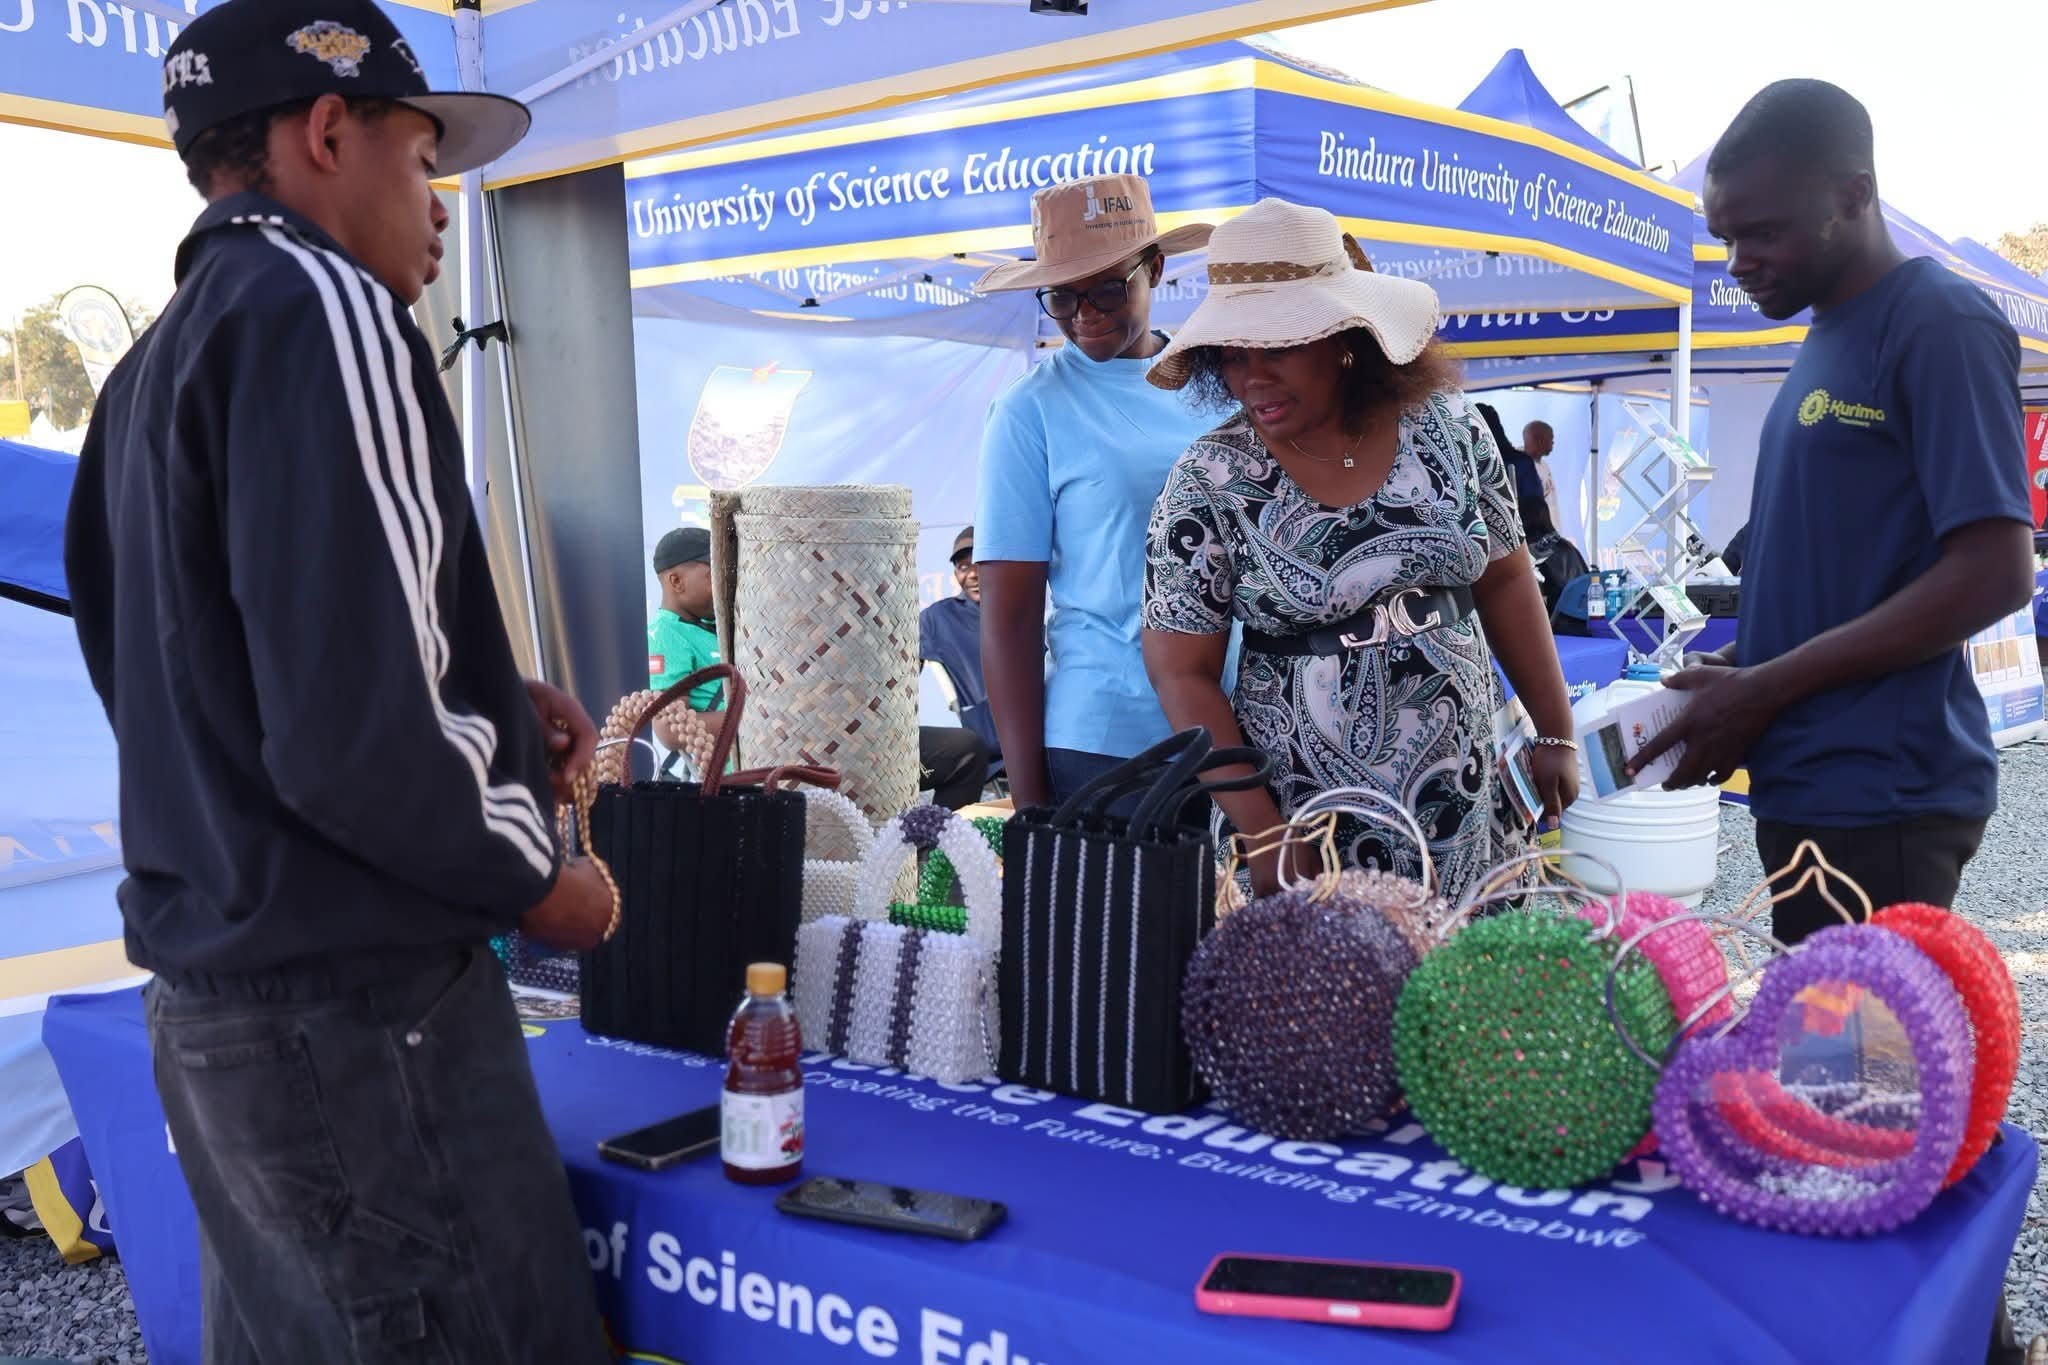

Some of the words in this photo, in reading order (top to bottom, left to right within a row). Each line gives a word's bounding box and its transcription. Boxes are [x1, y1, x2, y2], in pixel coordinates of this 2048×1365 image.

[633, 183, 775, 239] University
[785, 171, 827, 226] of
[827, 165, 950, 212] Science
[963, 135, 1155, 195] Education
[1318, 130, 1416, 189] Bindura
[1421, 148, 1520, 216] University
[1523, 172, 1546, 221] of
[1545, 178, 1603, 230] Science
[1603, 198, 1670, 254] Education
[1829, 399, 1886, 423] Kurima
[803, 1071, 956, 1112] Creating
[951, 1101, 1021, 1127] the
[1024, 1118, 1174, 1160] Future:
[1178, 1151, 1376, 1204] Building
[581, 1220, 629, 1279] of
[646, 1230, 899, 1359] Science
